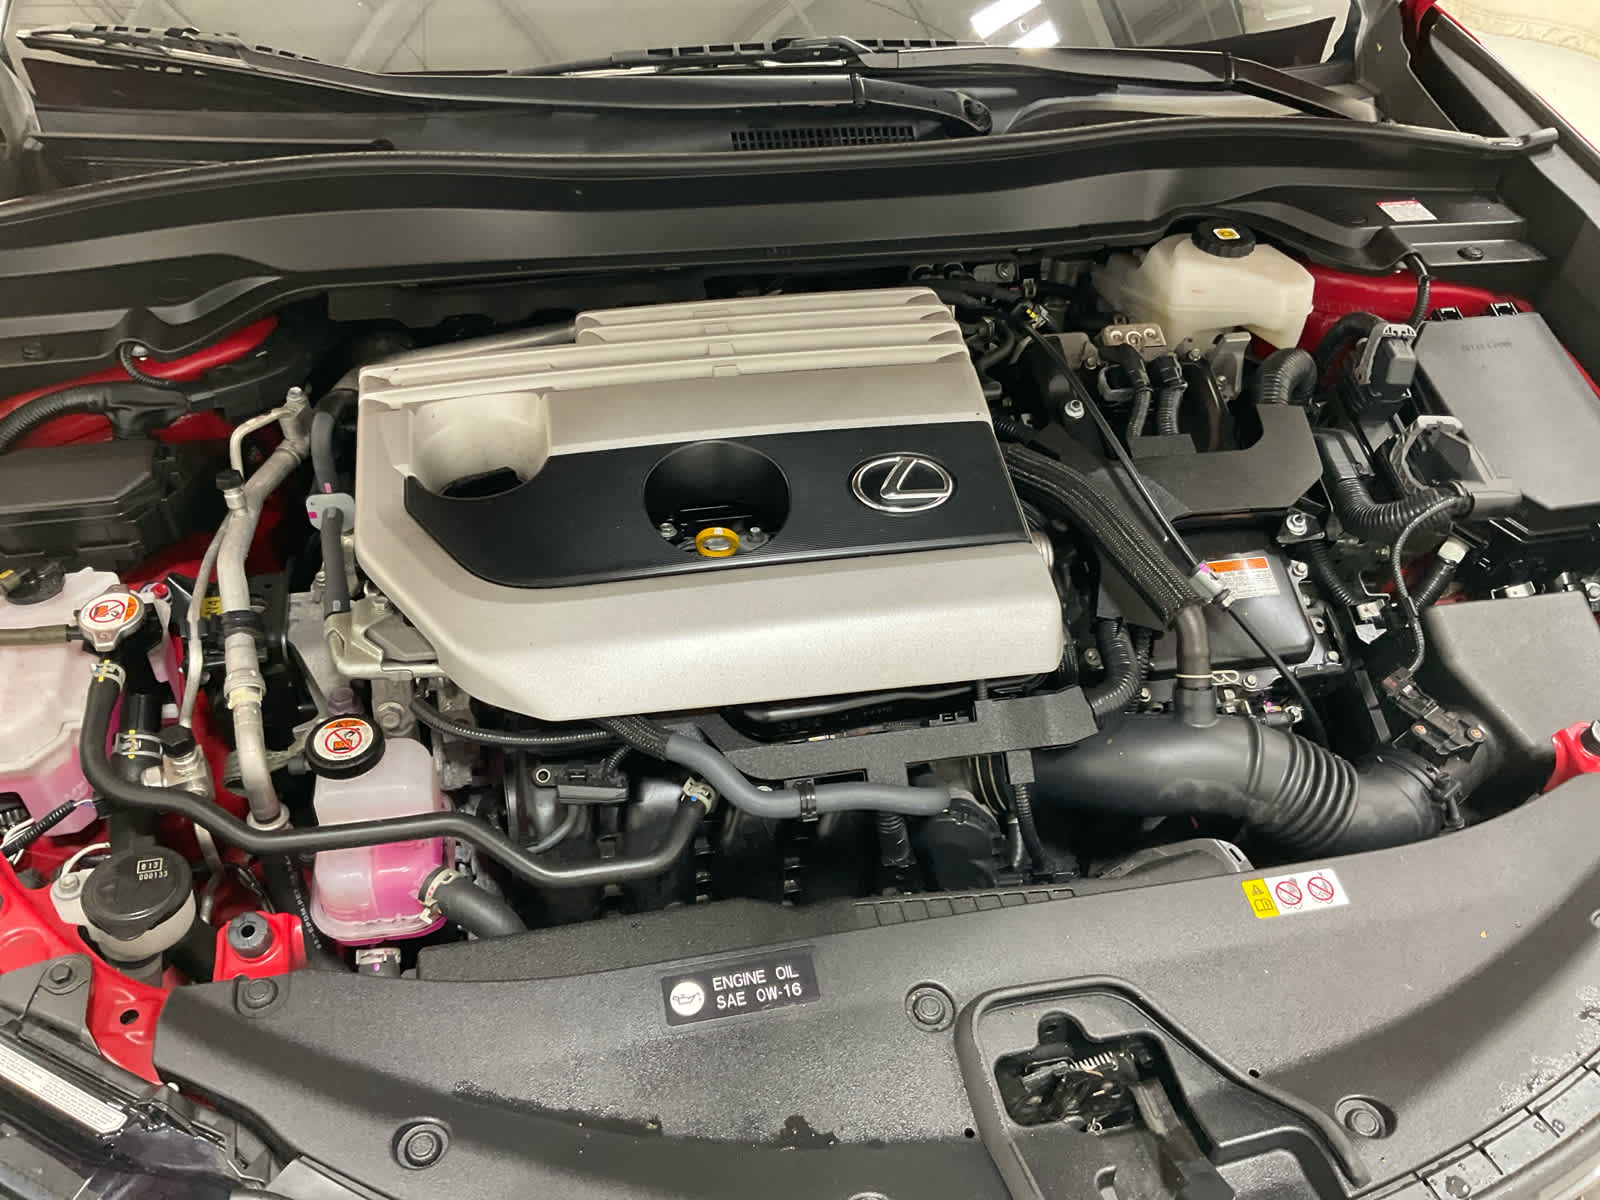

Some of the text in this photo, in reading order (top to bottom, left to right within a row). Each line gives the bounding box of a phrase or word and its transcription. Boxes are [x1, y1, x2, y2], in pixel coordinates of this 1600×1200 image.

[712, 964, 800, 991] ENGINE OIL
[716, 982, 802, 1009] SAE 0W-16
